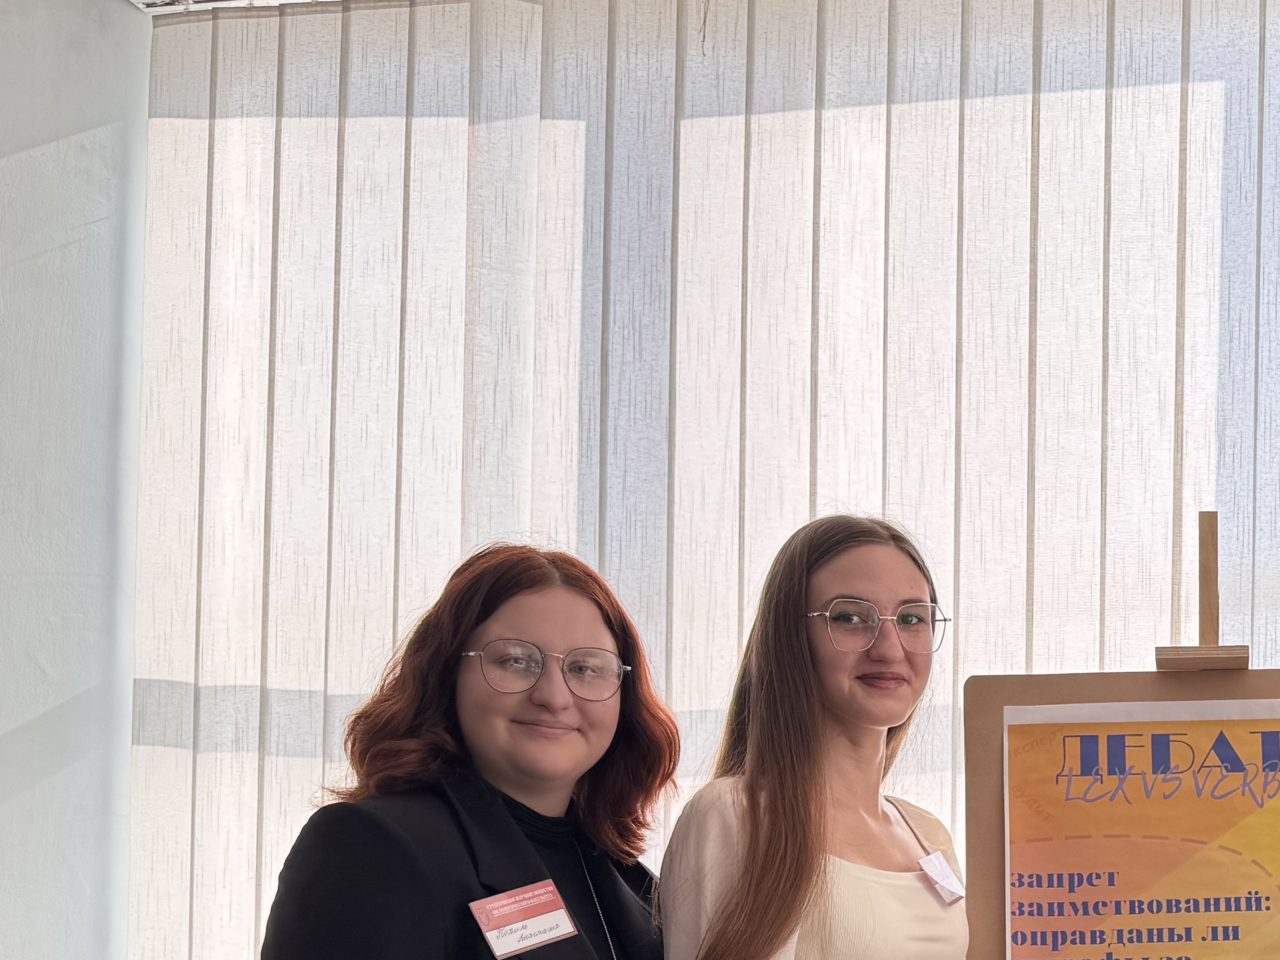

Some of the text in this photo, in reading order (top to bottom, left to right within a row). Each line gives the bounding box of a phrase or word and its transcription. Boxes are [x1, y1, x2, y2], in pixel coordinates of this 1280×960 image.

[1064, 765, 1136, 805] LEX
[1142, 764, 1186, 801] VS
[1010, 871, 1120, 893] запрет
[1010, 890, 1272, 917] заимствований:
[1011, 925, 1242, 951] оправданы ли
